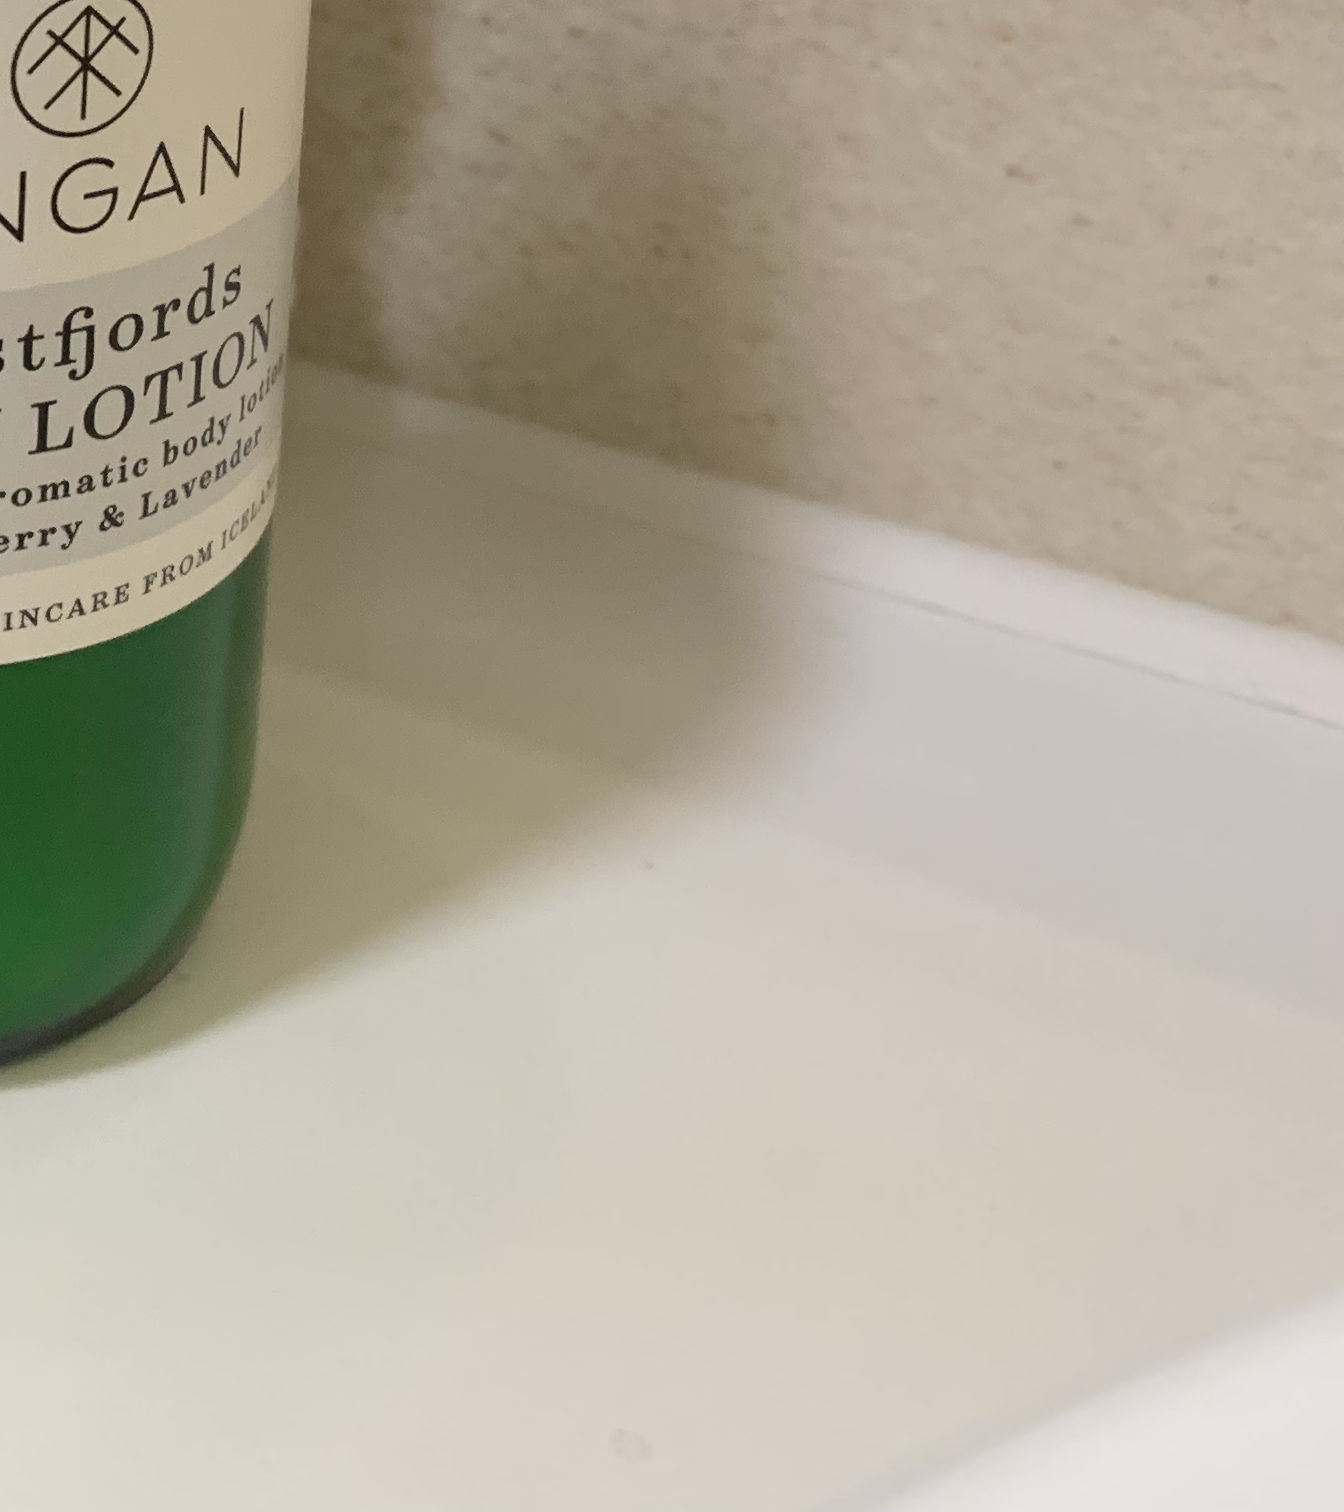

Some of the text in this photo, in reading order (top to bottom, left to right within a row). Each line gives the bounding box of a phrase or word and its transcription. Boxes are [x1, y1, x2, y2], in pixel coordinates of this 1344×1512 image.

[27, 299, 275, 457] LOTION
[98, 503, 126, 531] &
[138, 424, 263, 521] Lavender
[162, 414, 232, 469] body
[142, 541, 214, 595] FROM
[220, 473, 274, 551] ICELAN
